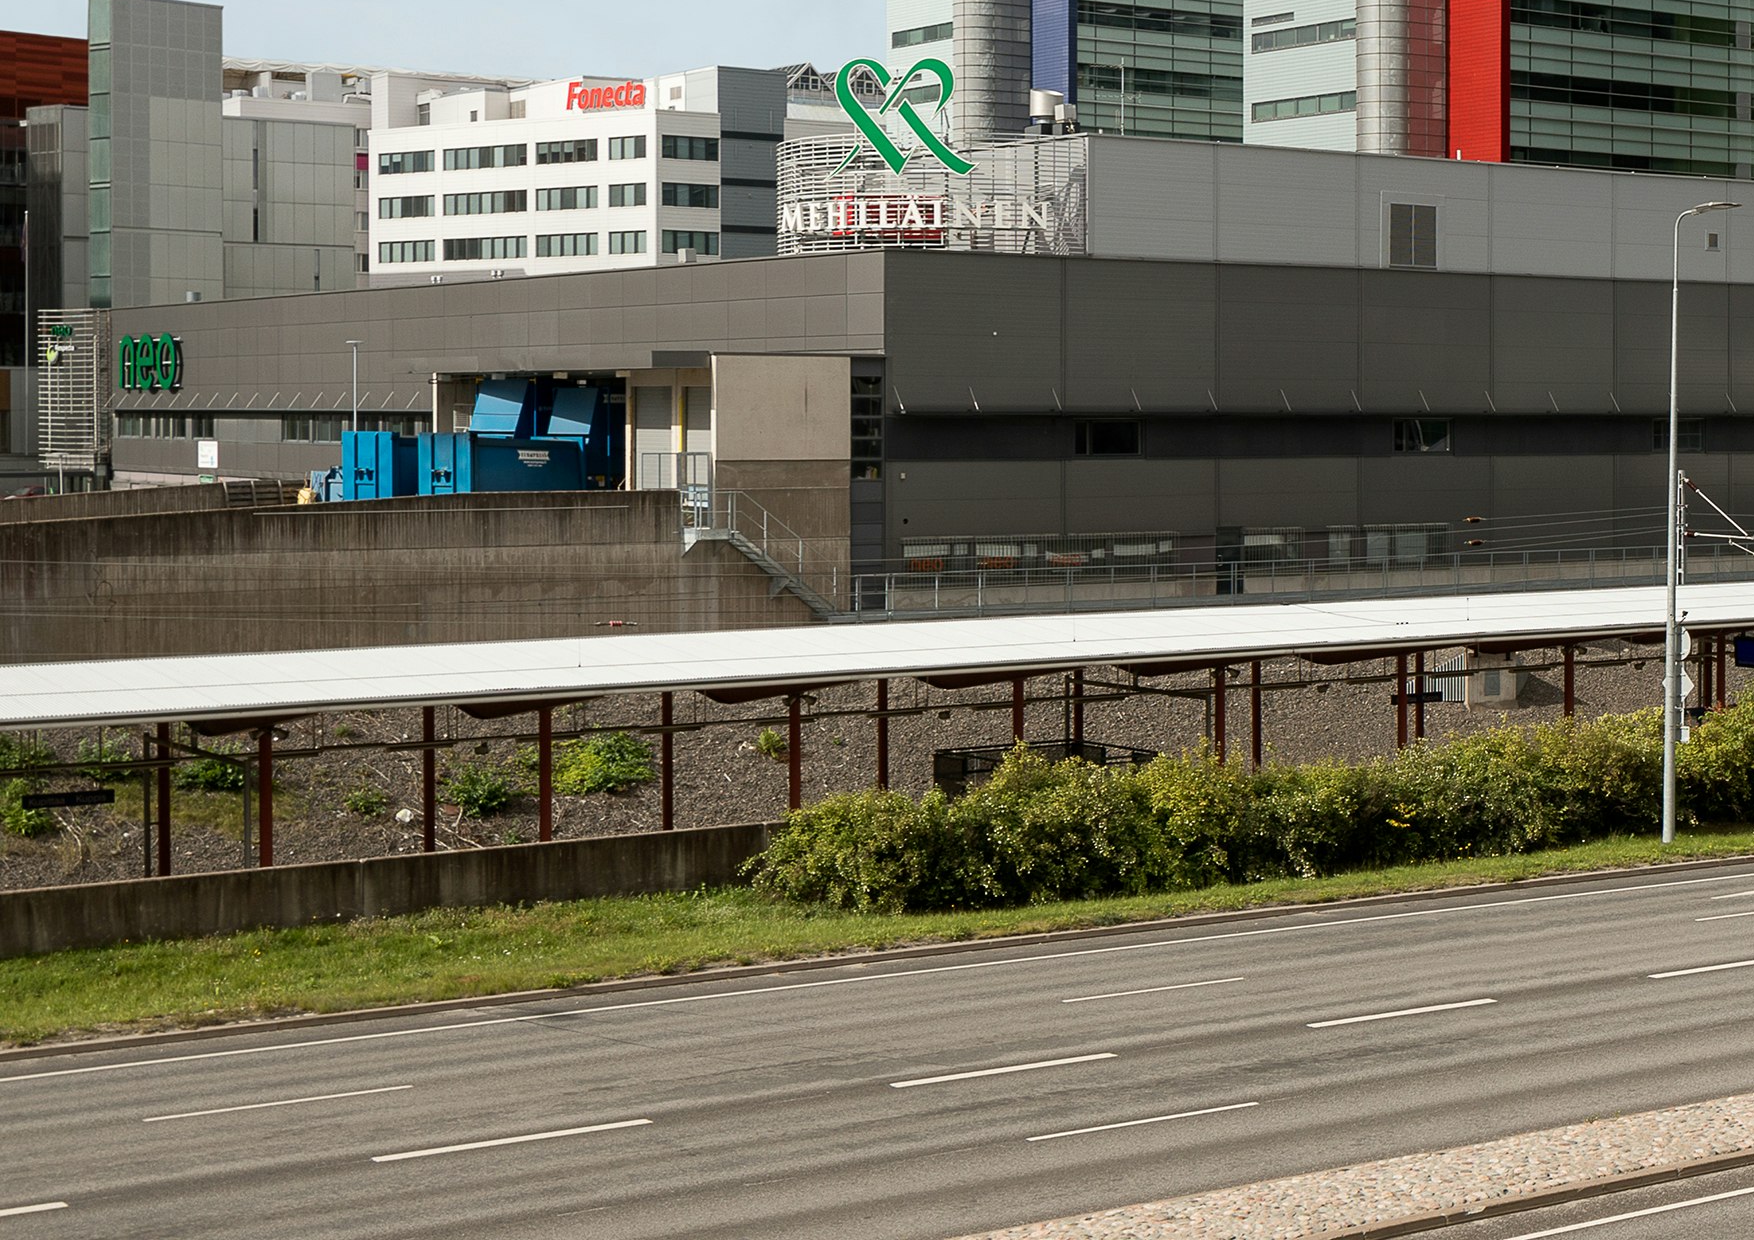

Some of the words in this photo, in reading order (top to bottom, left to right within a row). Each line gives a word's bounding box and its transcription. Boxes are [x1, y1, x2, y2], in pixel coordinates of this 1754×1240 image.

[566, 81, 646, 110] Fonecta
[781, 194, 1052, 232] MEHILÄINEN
[119, 332, 176, 390] neo
